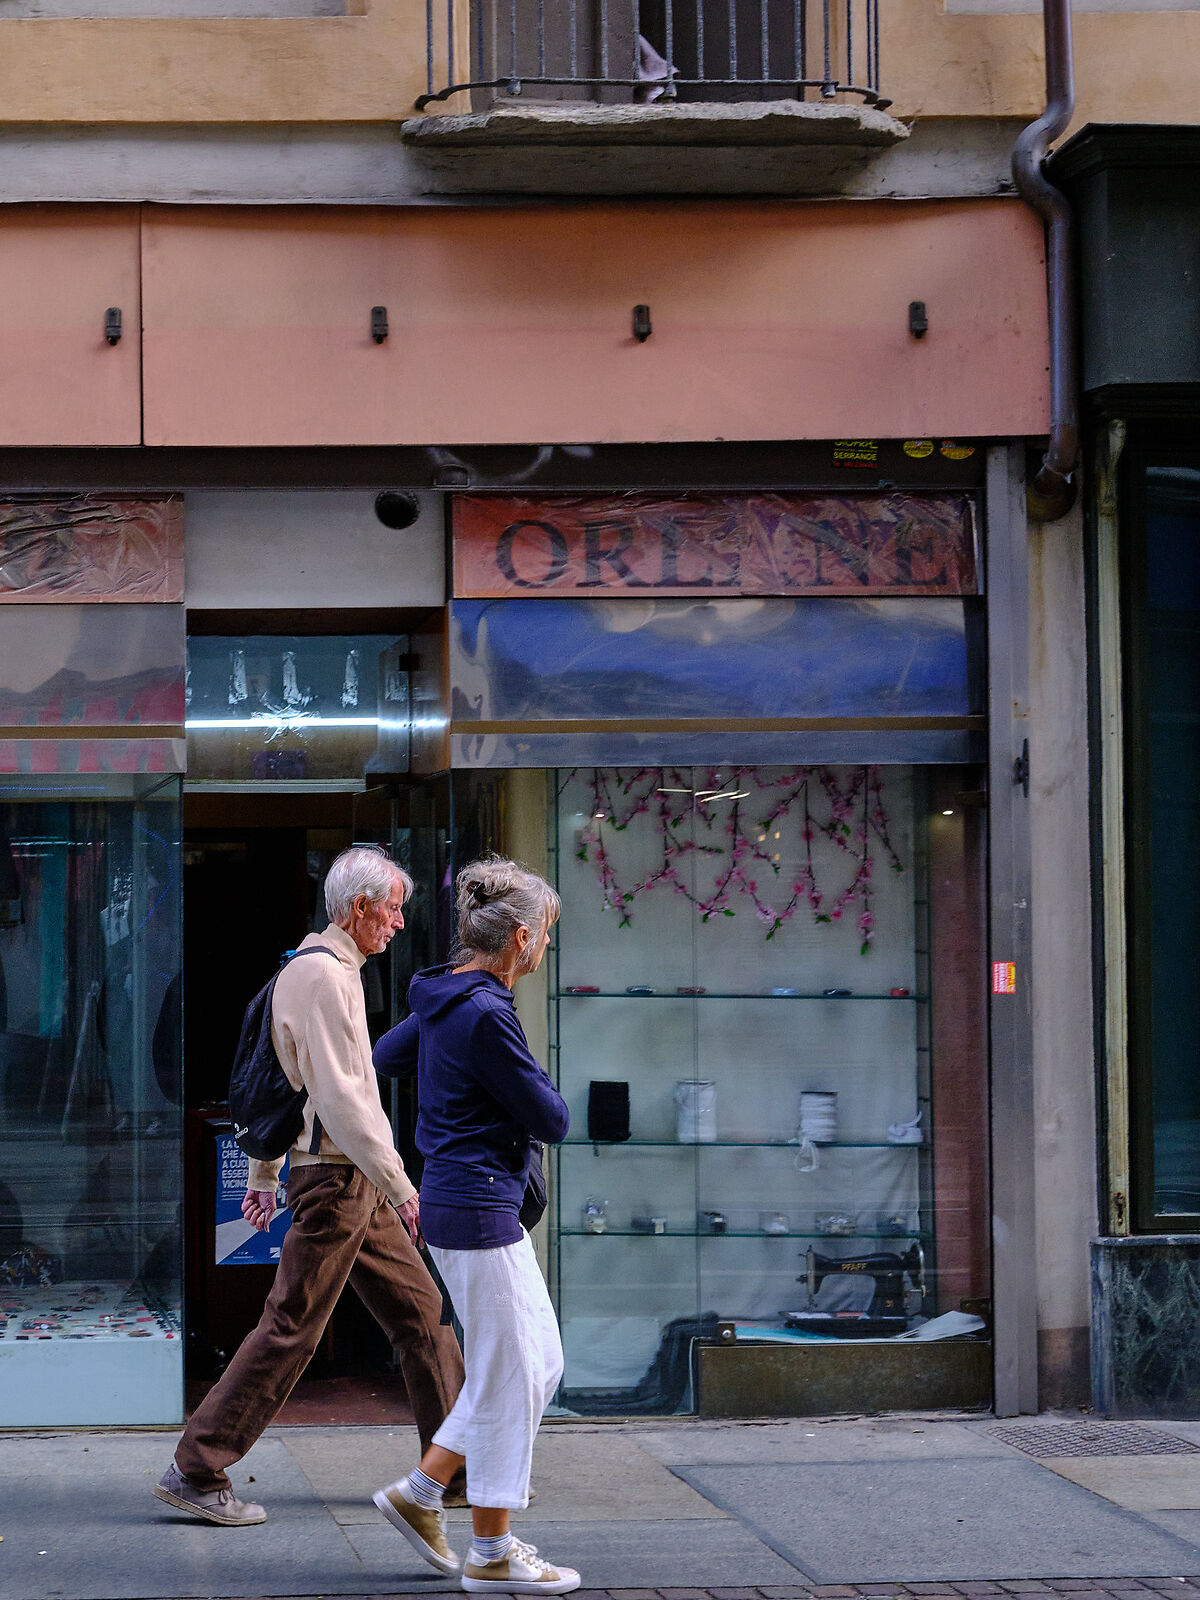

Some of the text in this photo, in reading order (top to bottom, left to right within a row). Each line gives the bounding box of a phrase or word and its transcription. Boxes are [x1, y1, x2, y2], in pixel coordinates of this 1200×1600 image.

[495, 519, 947, 589] ORLNE
[221, 1140, 233, 1149] LA
[221, 1150, 239, 1159] CHE
[222, 1159, 249, 1169] A CUO
[221, 1169, 249, 1179] ESSER
[841, 1262, 869, 1271] PFAFF
